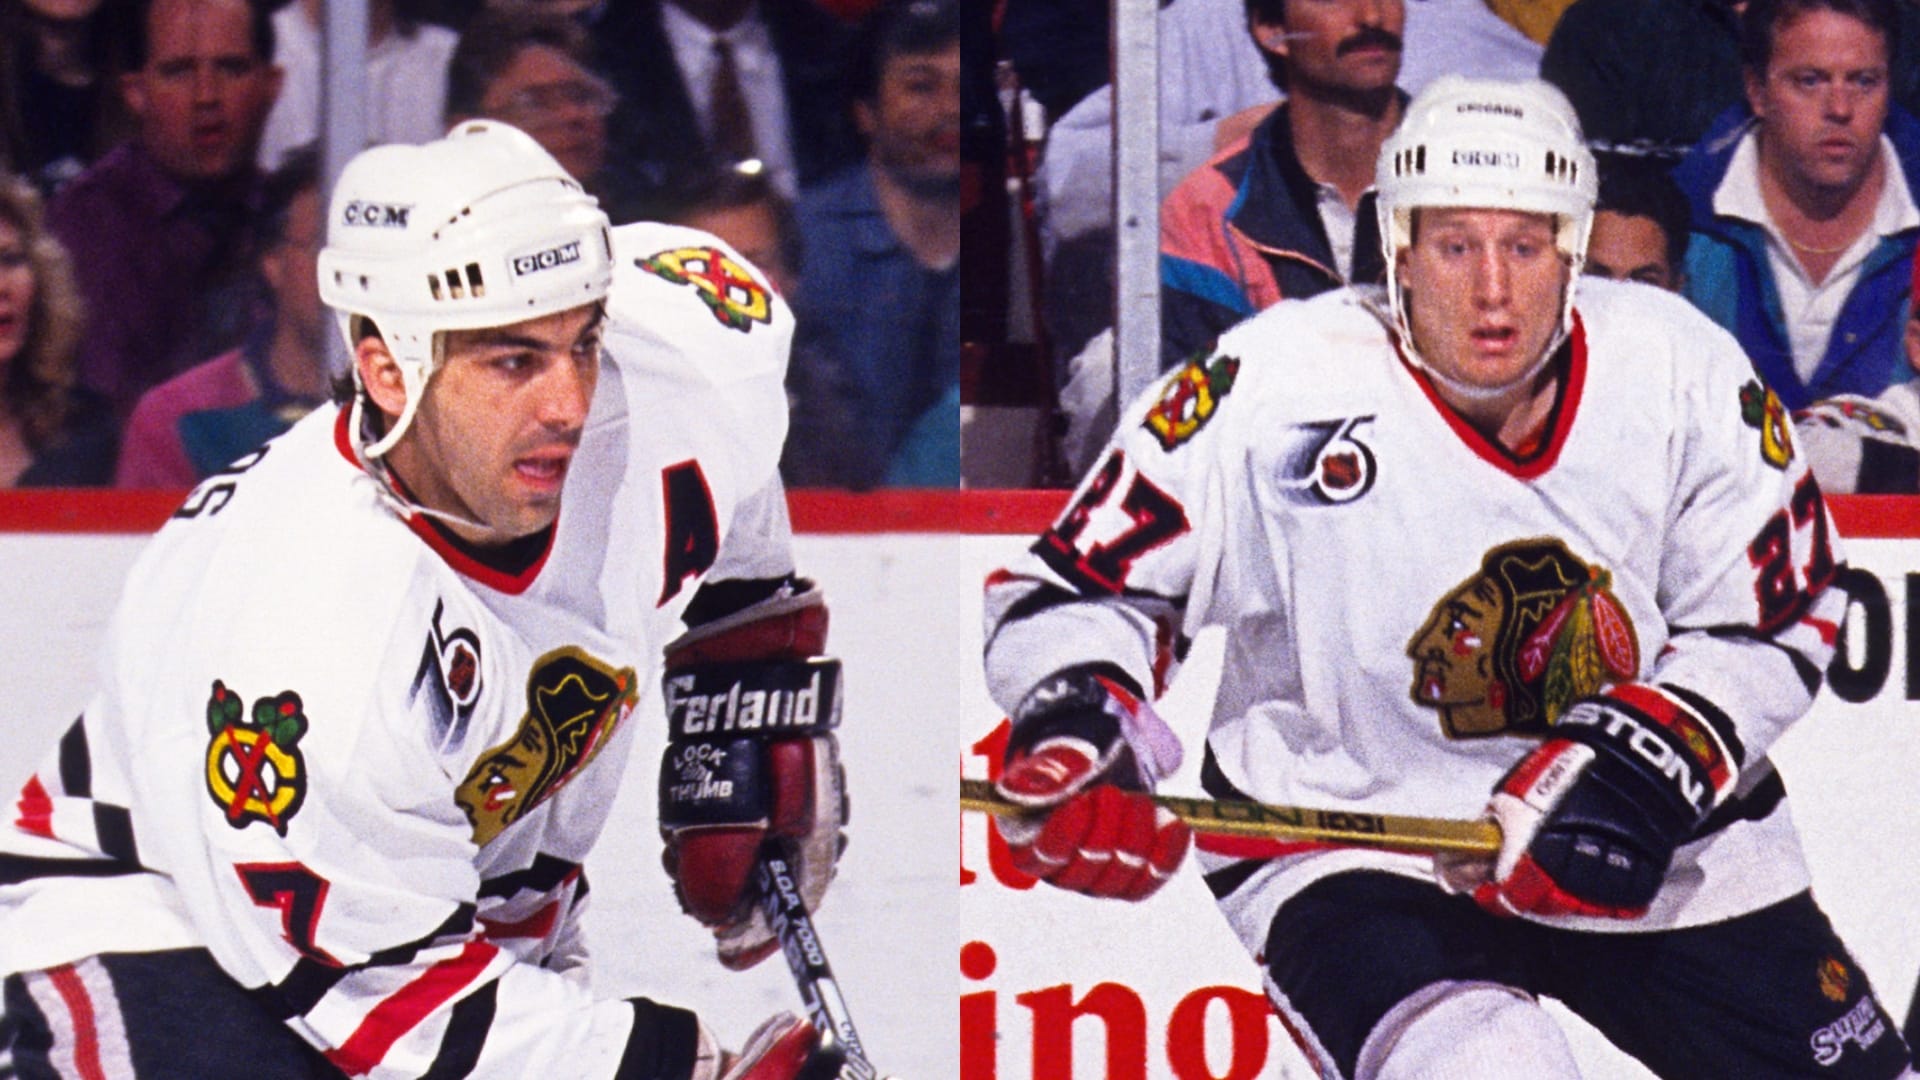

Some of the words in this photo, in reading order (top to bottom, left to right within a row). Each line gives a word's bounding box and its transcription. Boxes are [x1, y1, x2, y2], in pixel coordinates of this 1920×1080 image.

[343, 202, 409, 227] CCM
[513, 244, 580, 275] CCM
[656, 458, 720, 609] A
[1747, 466, 1837, 634] 27
[667, 671, 821, 734] Ferland
[1557, 702, 1705, 815] STON
[233, 861, 345, 969] 7
